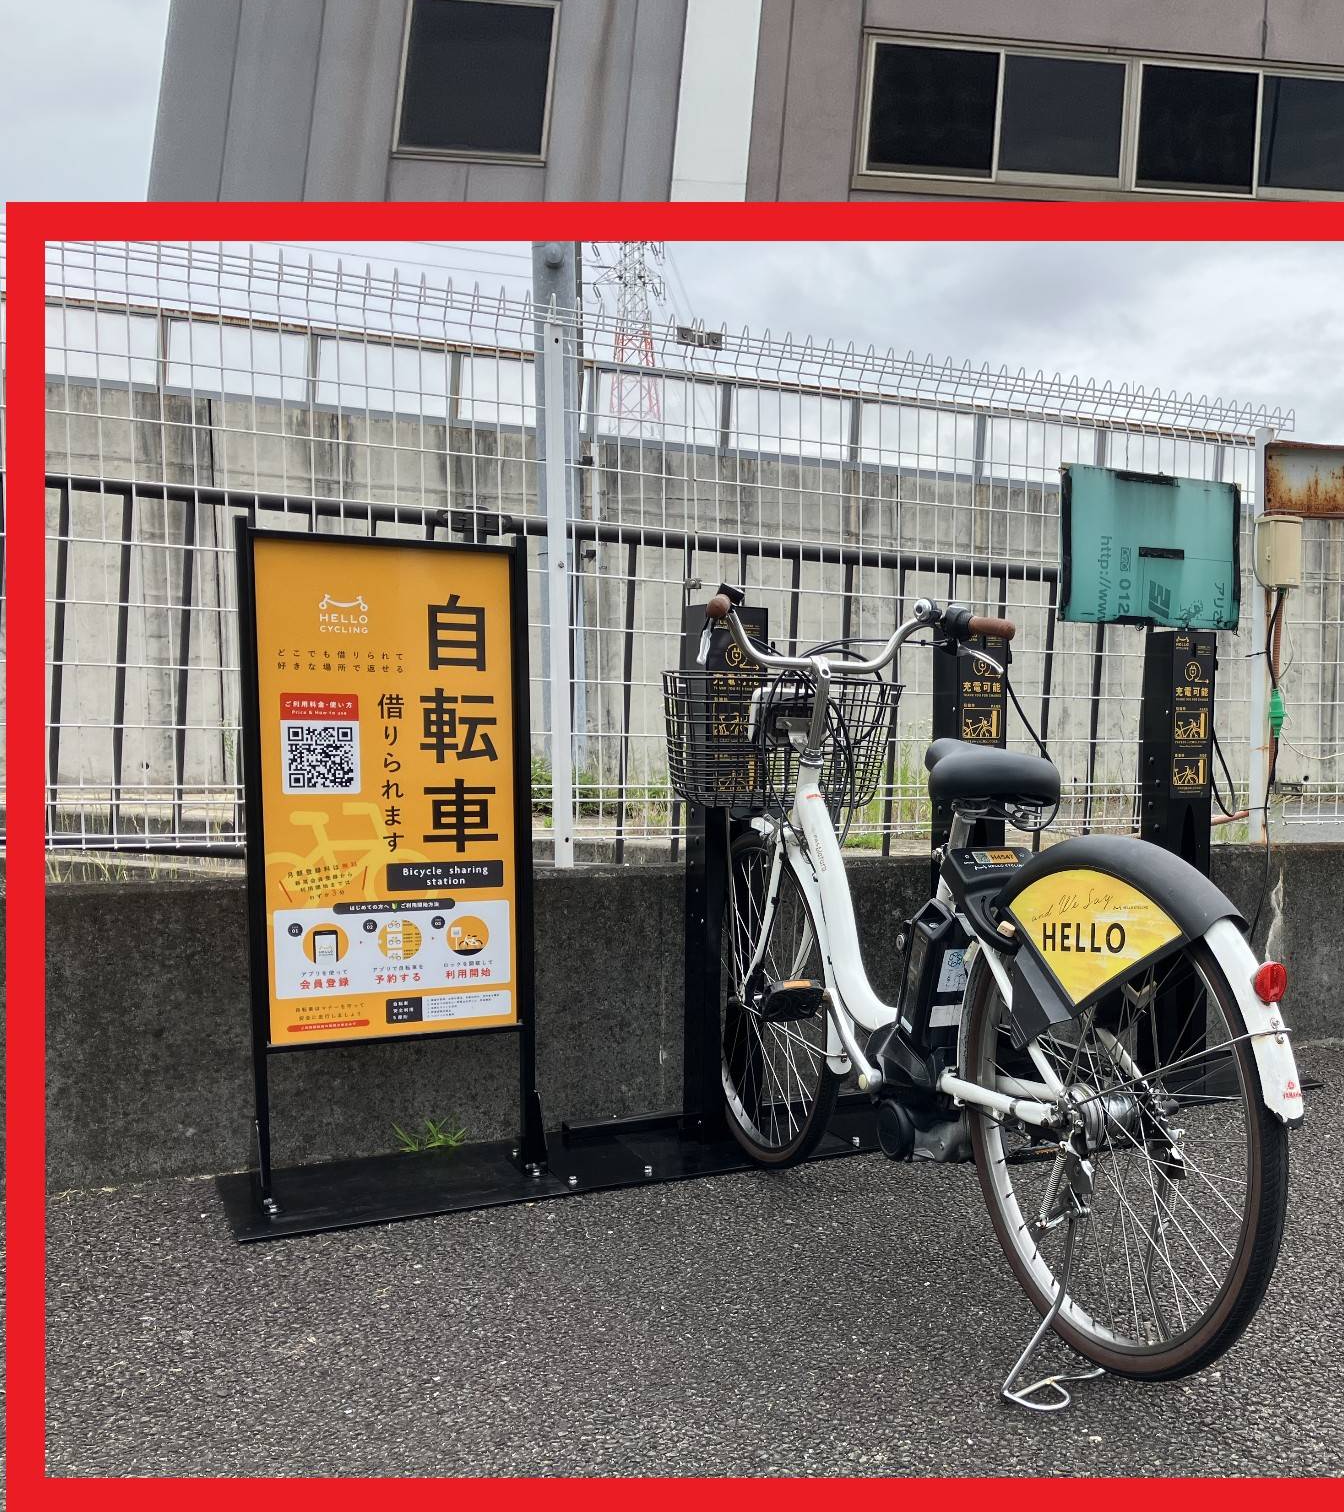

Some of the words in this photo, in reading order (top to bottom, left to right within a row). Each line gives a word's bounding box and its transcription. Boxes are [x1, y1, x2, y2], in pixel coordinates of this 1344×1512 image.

[319, 613, 368, 624] HELLO
[319, 625, 368, 634] CYCLING
[277, 649, 404, 661] どこでも借りられて
[277, 661, 404, 673] 好きな場所で返せる
[963, 682, 1001, 693] 充電可能
[1175, 686, 1209, 697] 充電可能
[419, 593, 499, 853] 自転車
[377, 693, 405, 853] 借りられます
[402, 867, 442, 877] Bicycle
[449, 866, 489, 876] sharing
[426, 877, 466, 886] station
[1031, 904, 1054, 922] and
[1058, 894, 1080, 916] We
[1083, 888, 1114, 910] Say
[1042, 922, 1126, 954] HELLO
[375, 972, 422, 985] 予約する
[445, 967, 492, 980] 利用開始
[300, 977, 350, 990] 会員登録
